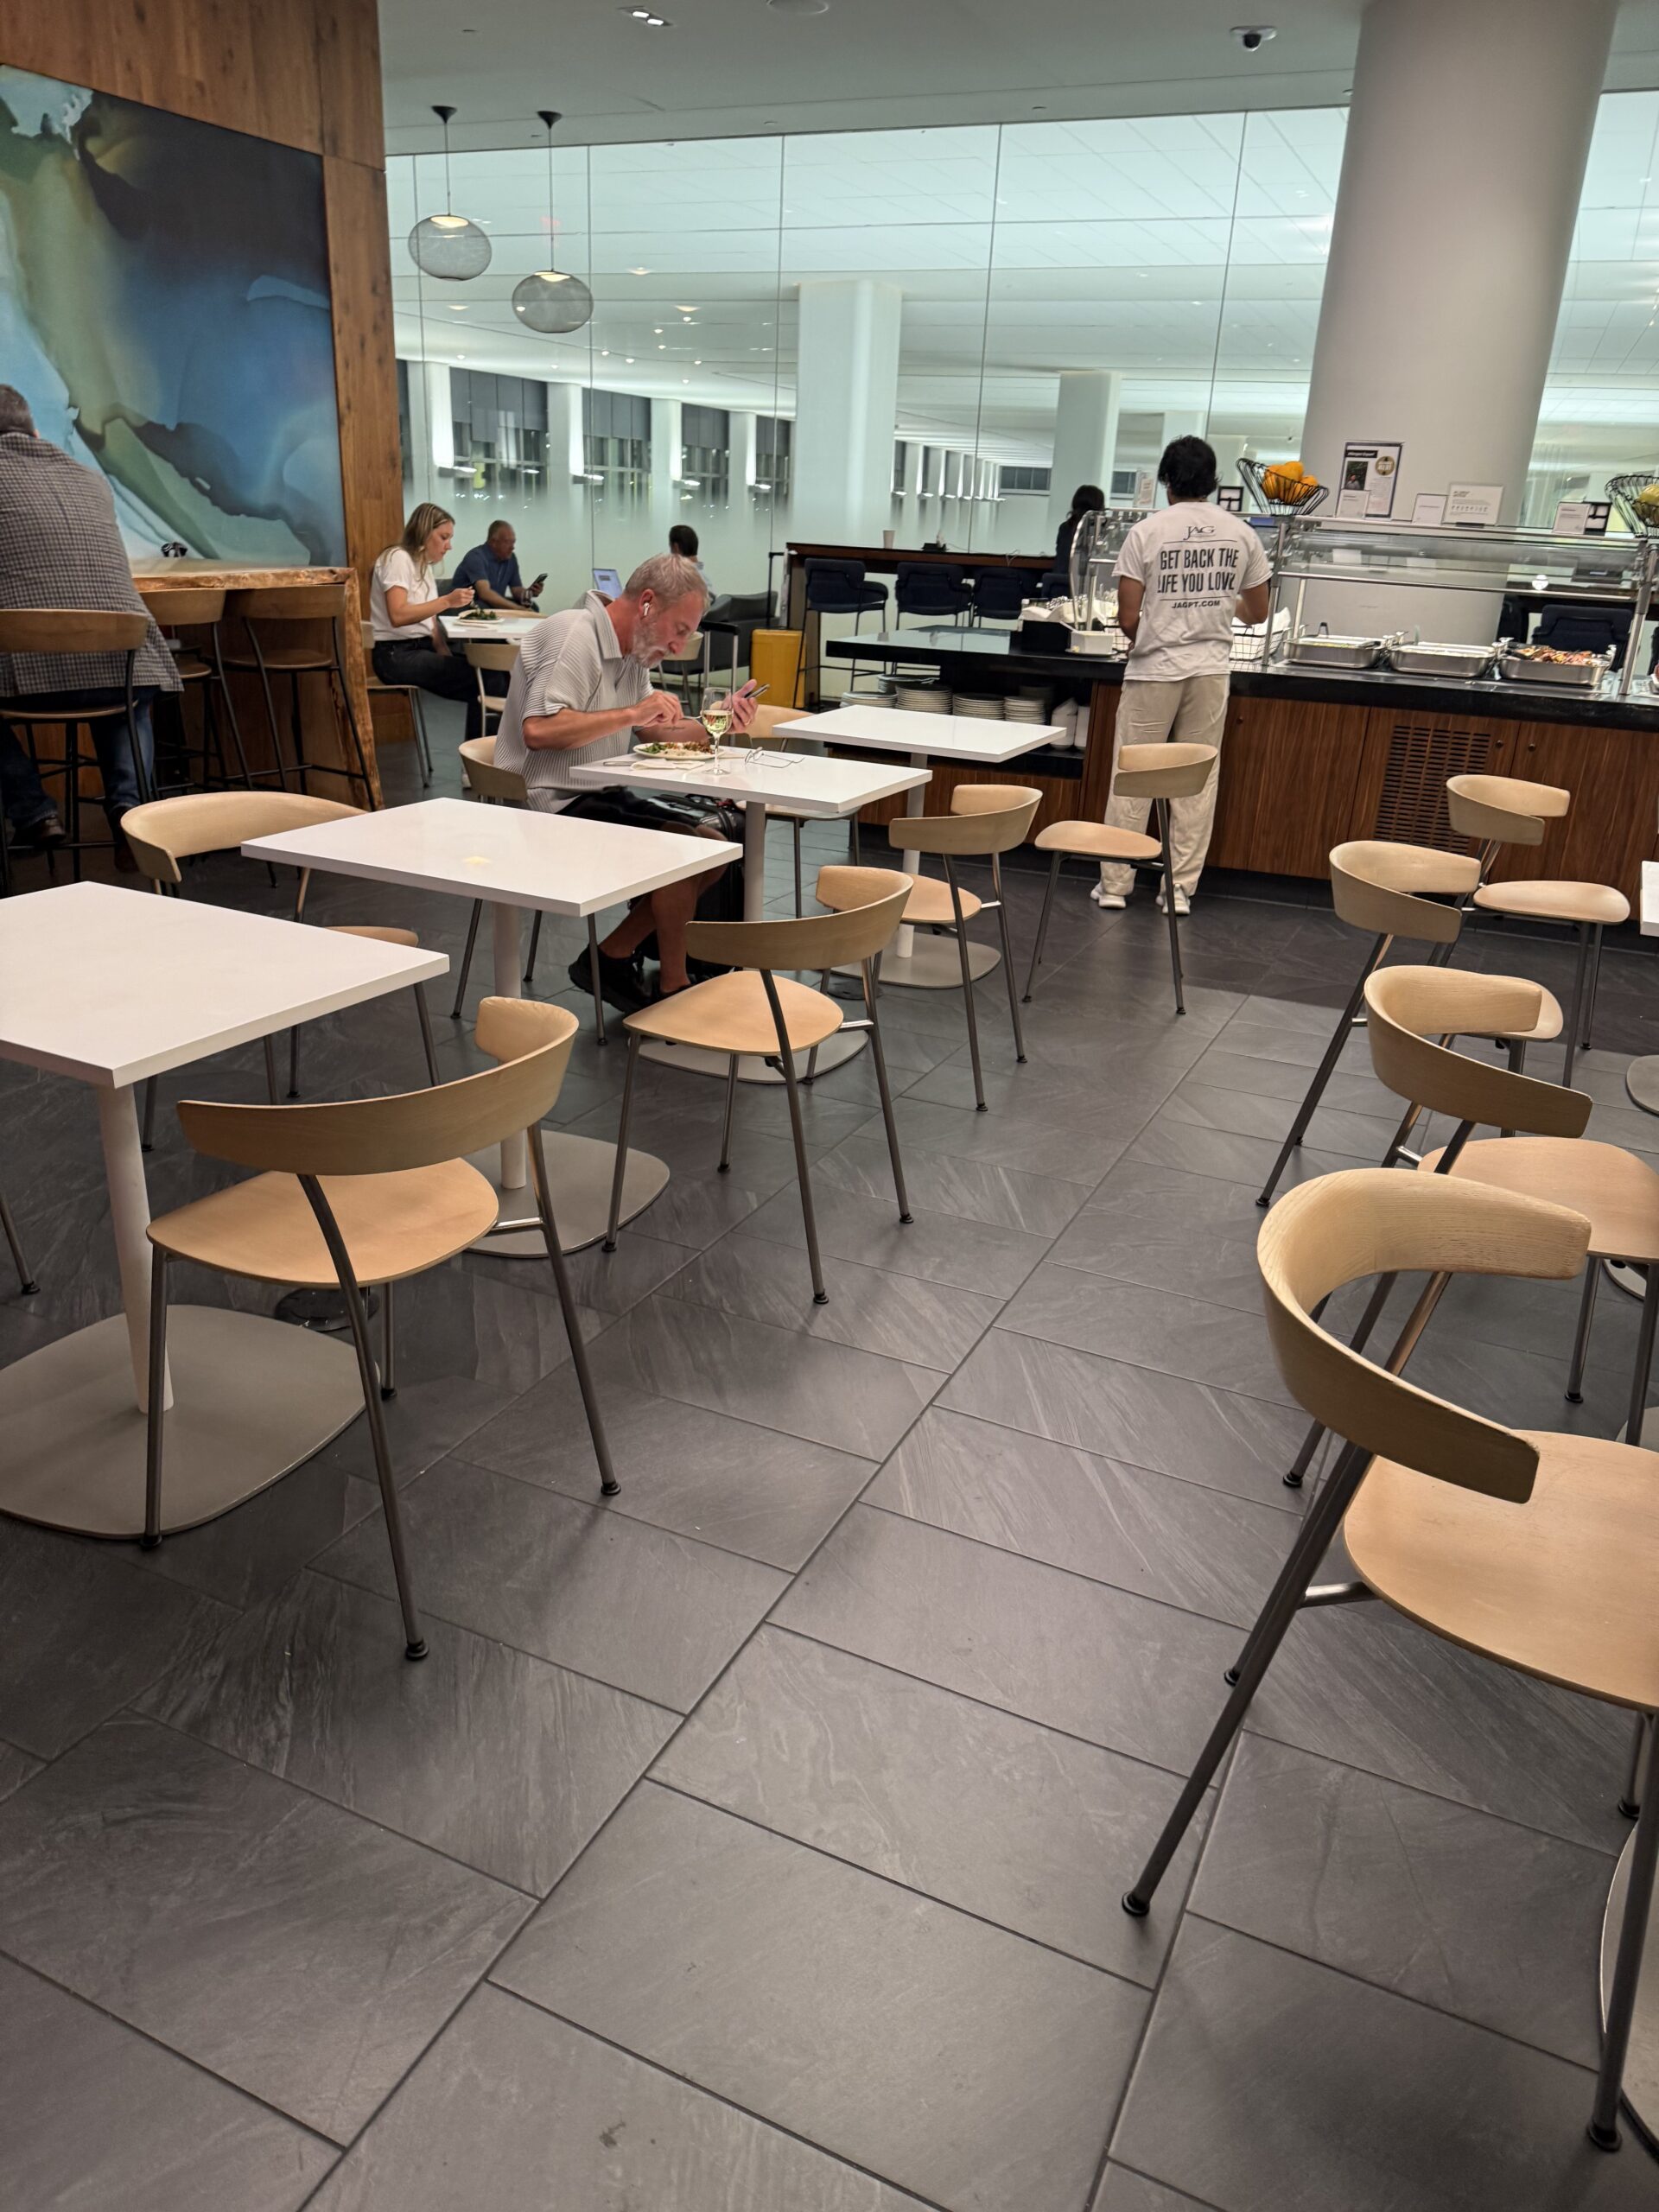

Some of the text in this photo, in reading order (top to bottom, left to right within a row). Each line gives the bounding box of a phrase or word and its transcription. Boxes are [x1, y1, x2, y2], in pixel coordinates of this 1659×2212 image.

[1183, 525, 1215, 540] JAG
[1160, 548, 1239, 570] GET BACK THE
[1157, 572, 1236, 594] LIFE YOU LOVE
[1171, 601, 1221, 609] JAGPT.COM
